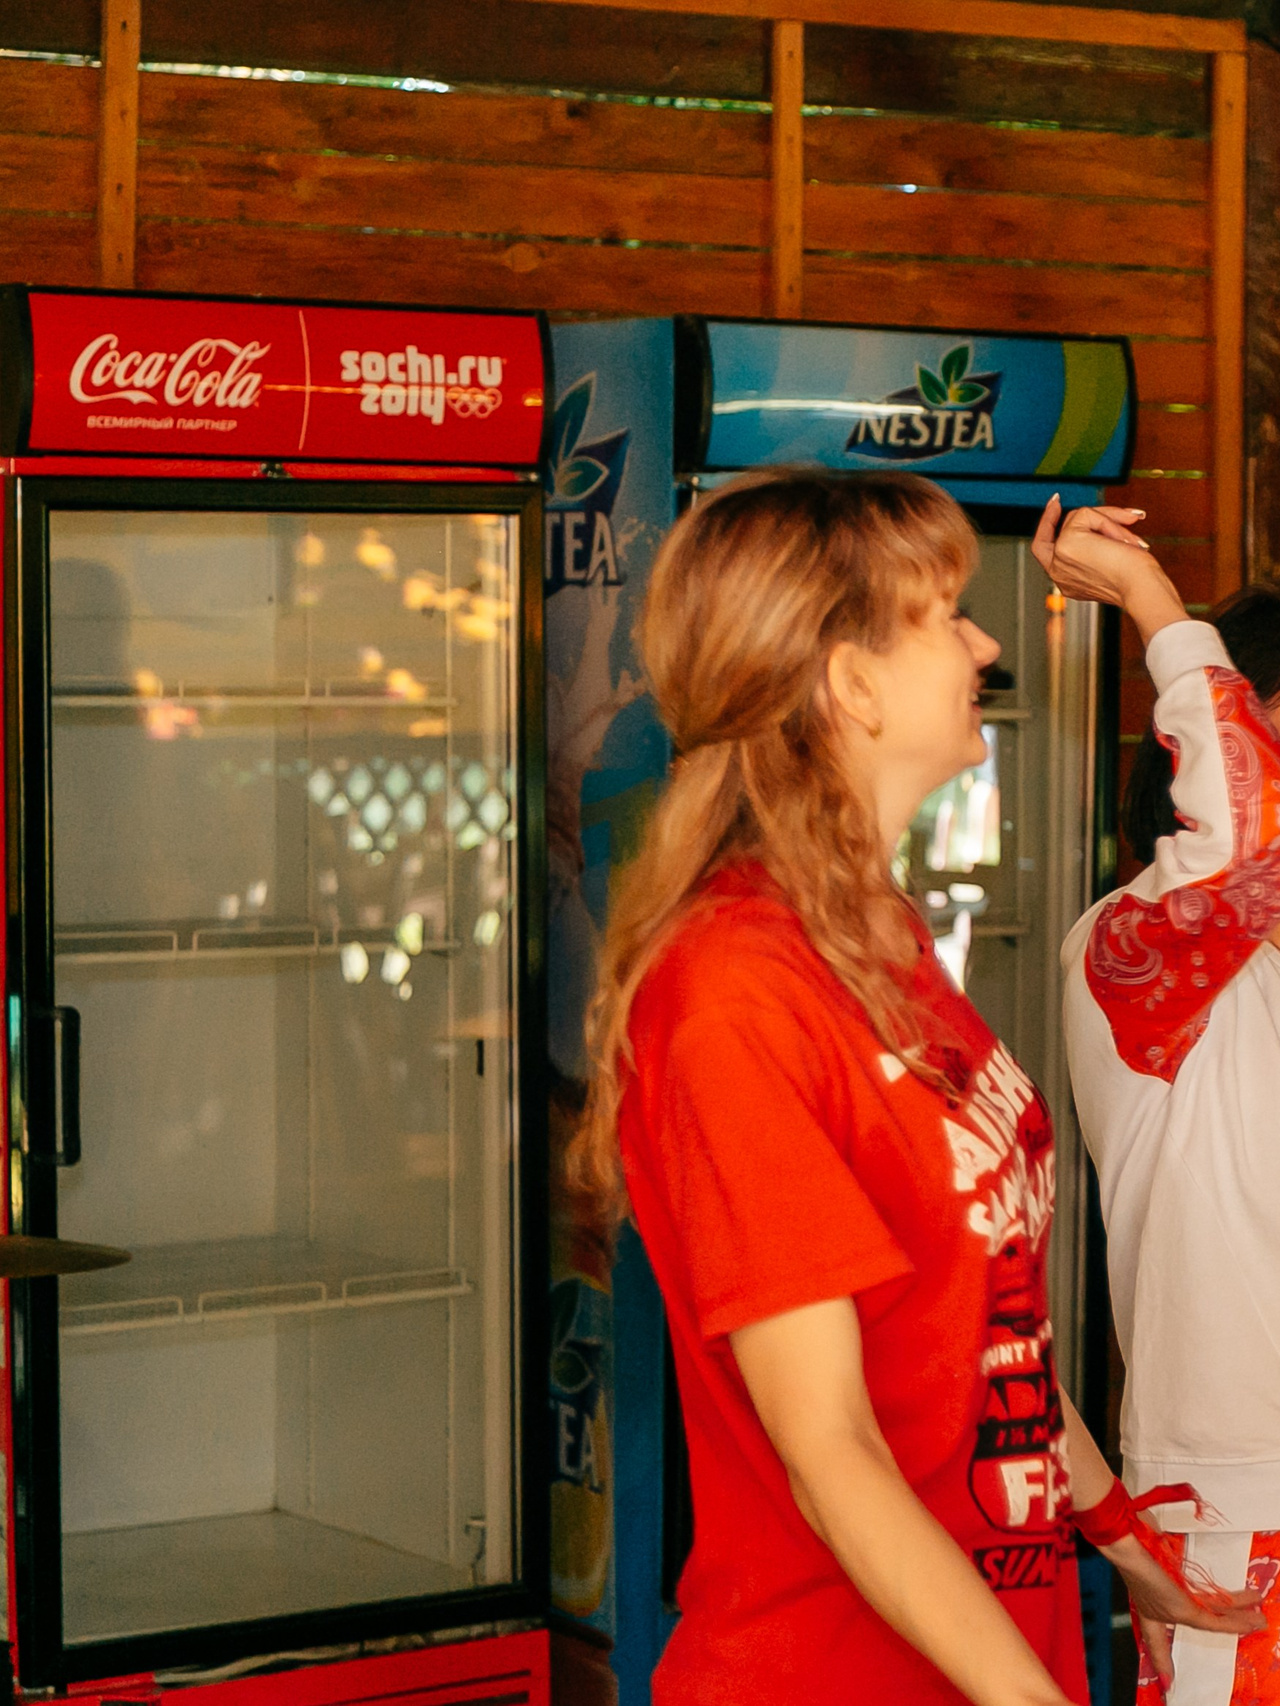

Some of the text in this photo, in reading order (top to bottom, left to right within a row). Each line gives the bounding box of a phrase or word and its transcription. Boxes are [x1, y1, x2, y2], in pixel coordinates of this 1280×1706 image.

[69, 334, 271, 408] Coca-Cola
[340, 345, 502, 385] sochi.ru
[86, 414, 238, 433] ВСЕМИРНЫЙ ПАРТНЕР
[359, 382, 446, 426] 2014
[857, 409, 995, 450] NESTEA
[545, 511, 619, 581] TEA
[549, 1396, 600, 1488] EA
